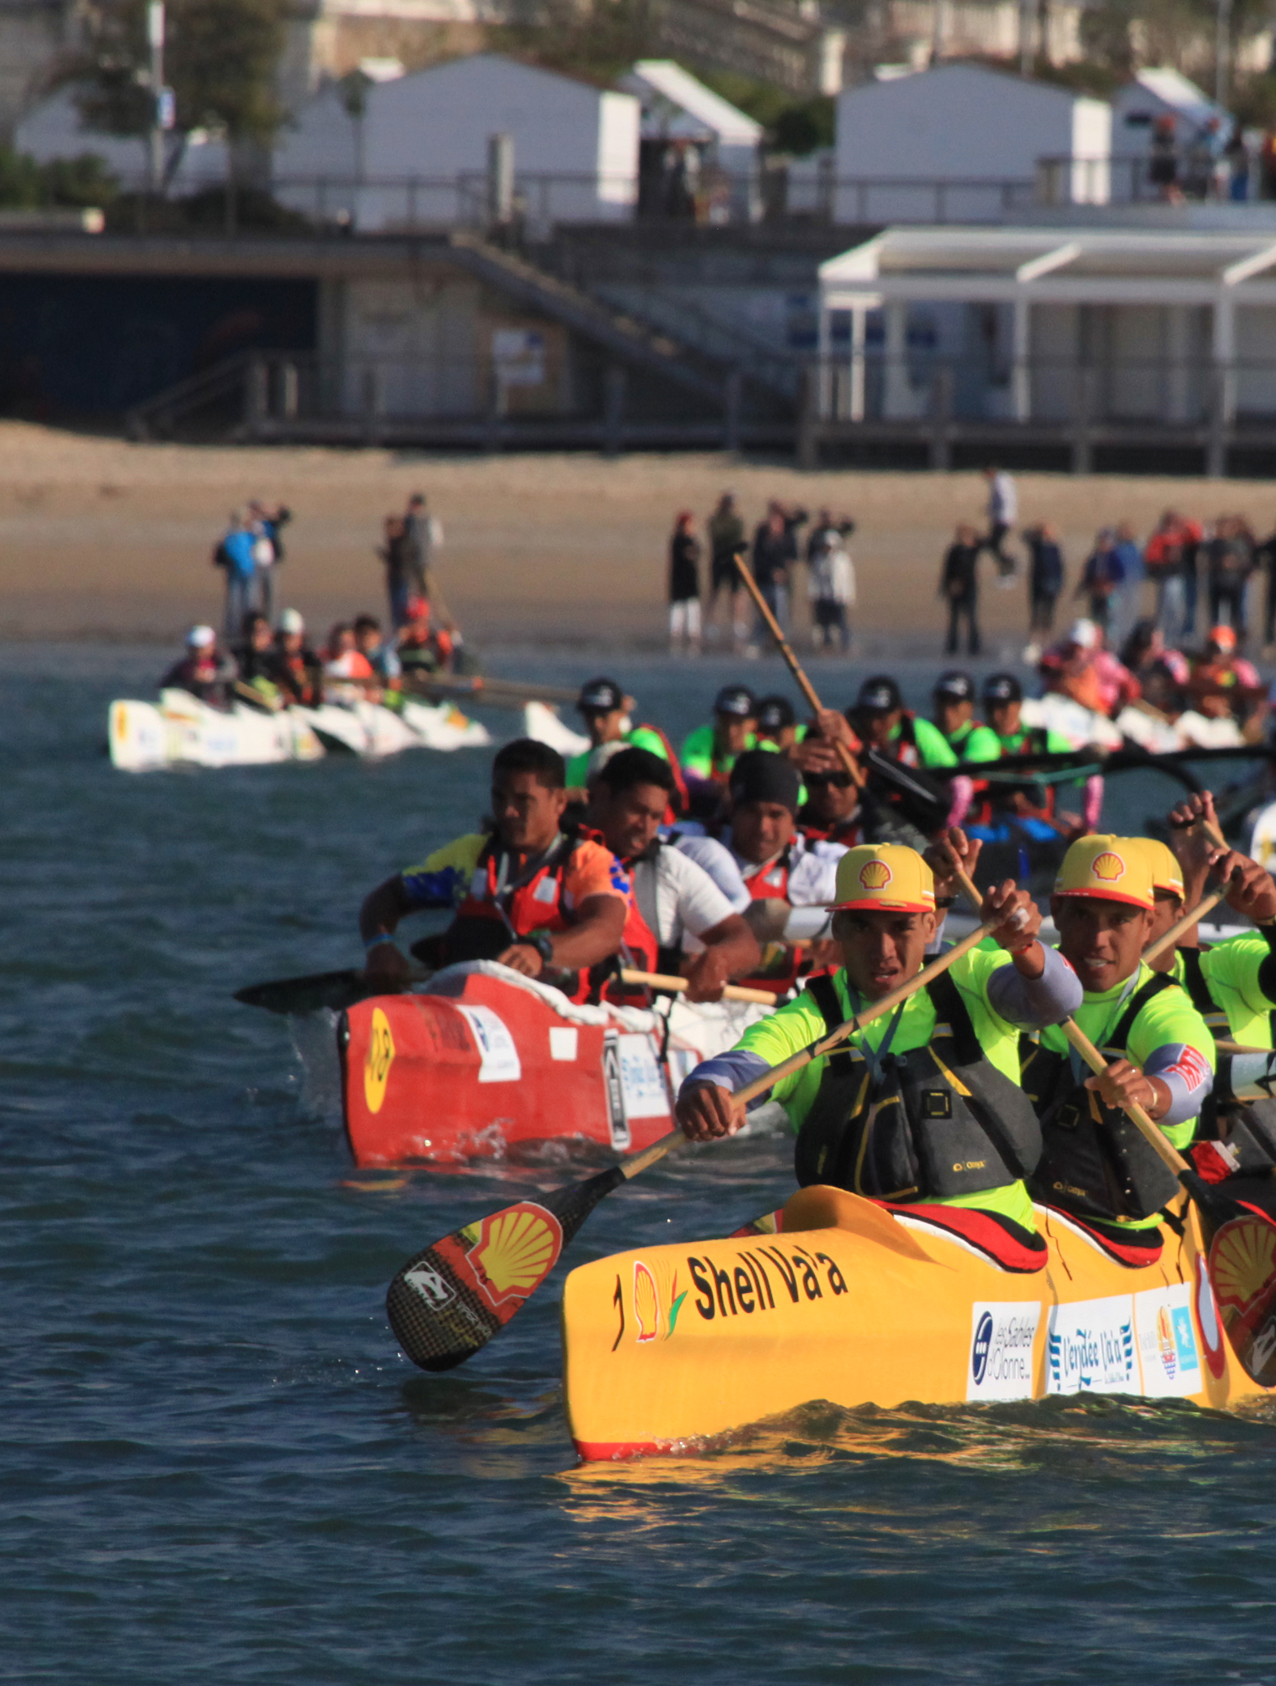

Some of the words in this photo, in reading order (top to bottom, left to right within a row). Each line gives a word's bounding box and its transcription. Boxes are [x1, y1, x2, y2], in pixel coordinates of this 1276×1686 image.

[687, 1251, 775, 1320] Shell
[756, 1245, 849, 1303] Va'a
[1004, 1316, 1035, 1348] Sables
